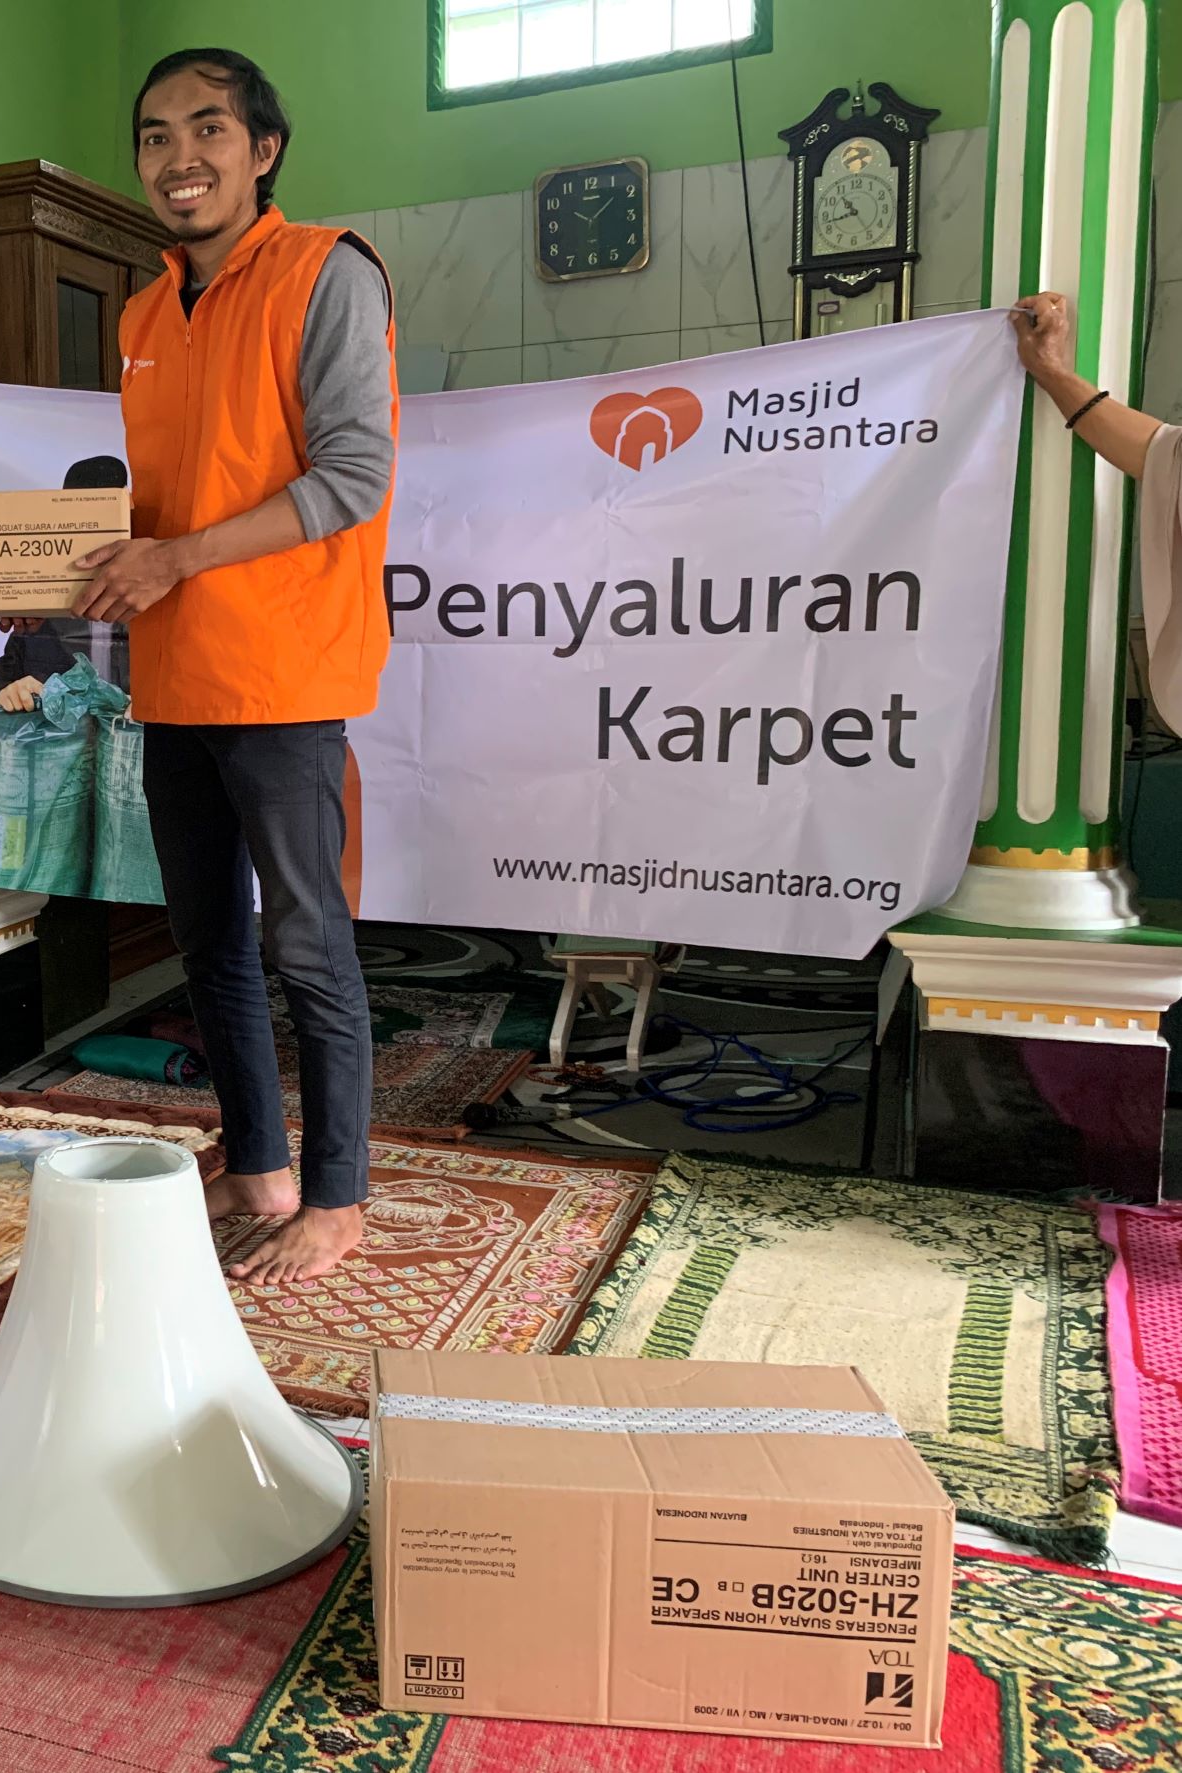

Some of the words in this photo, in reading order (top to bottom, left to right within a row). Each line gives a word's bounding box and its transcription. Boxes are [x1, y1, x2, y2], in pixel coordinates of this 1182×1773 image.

[563, 182, 573, 195] 11
[584, 177, 598, 190] 12
[837, 184, 846, 194] 11
[850, 178, 862, 190] 12
[626, 185, 635, 198] 2
[878, 190, 885, 200] 2
[547, 198, 559, 210] 10
[824, 196, 836, 207] 10
[882, 204, 888, 214] 3
[627, 209, 636, 221] 3
[822, 211, 829, 221] 9
[549, 221, 558, 233] 9
[877, 218, 883, 228] 4
[826, 224, 832, 235] 8
[866, 230, 873, 240] 5
[627, 233, 635, 245] 4
[837, 234, 842, 244] 7
[851, 236, 857, 246] 6
[550, 244, 558, 256] 8
[610, 249, 618, 261] 5
[566, 256, 575, 267] 7
[588, 252, 597, 265] 6
[728, 377, 860, 419] Masjid
[723, 417, 938, 454] Nusantara
[25, 523, 51, 531] SUARA
[57, 521, 99, 530] AMPLIFIER
[382, 557, 919, 658] Penyaluran
[598, 686, 917, 785] Karpet
[493, 857, 901, 911] www.masjidnusantara.org
[656, 1509, 708, 1518] INDONESIA
[710, 1512, 747, 1521] BUATAN
[839, 1520, 884, 1529] Indonesia
[893, 1523, 923, 1531] Bekasi
[793, 1527, 849, 1537] INDUSTRIES
[851, 1530, 884, 1539] GALVA
[886, 1532, 905, 1540] TOA
[908, 1533, 923, 1541] PT.
[852, 1540, 871, 1548] oleh
[873, 1541, 922, 1551] Diproduksi
[416, 1557, 462, 1565] Specification
[464, 1560, 504, 1568] Indonesian
[850, 1557, 921, 1570] IMPEDANSI
[445, 1566, 460, 1574] only
[796, 1568, 839, 1583] UNIT
[845, 1571, 920, 1588] CENTER
[652, 1576, 700, 1603] CE
[751, 1583, 919, 1619] ZH-5025B
[651, 1606, 721, 1621] SPEAKER
[724, 1611, 766, 1624] HORN
[781, 1615, 831, 1629] SUARA
[835, 1620, 917, 1635] PENGERAS
[869, 1649, 914, 1667] TOA
[694, 1705, 718, 1715] 2009
[727, 1708, 740, 1717] VII
[749, 1710, 766, 1719] MG
[776, 1713, 848, 1726] INDAG-ILMEA
[857, 1719, 883, 1729] 10.27
[893, 1722, 911, 1731] 004
